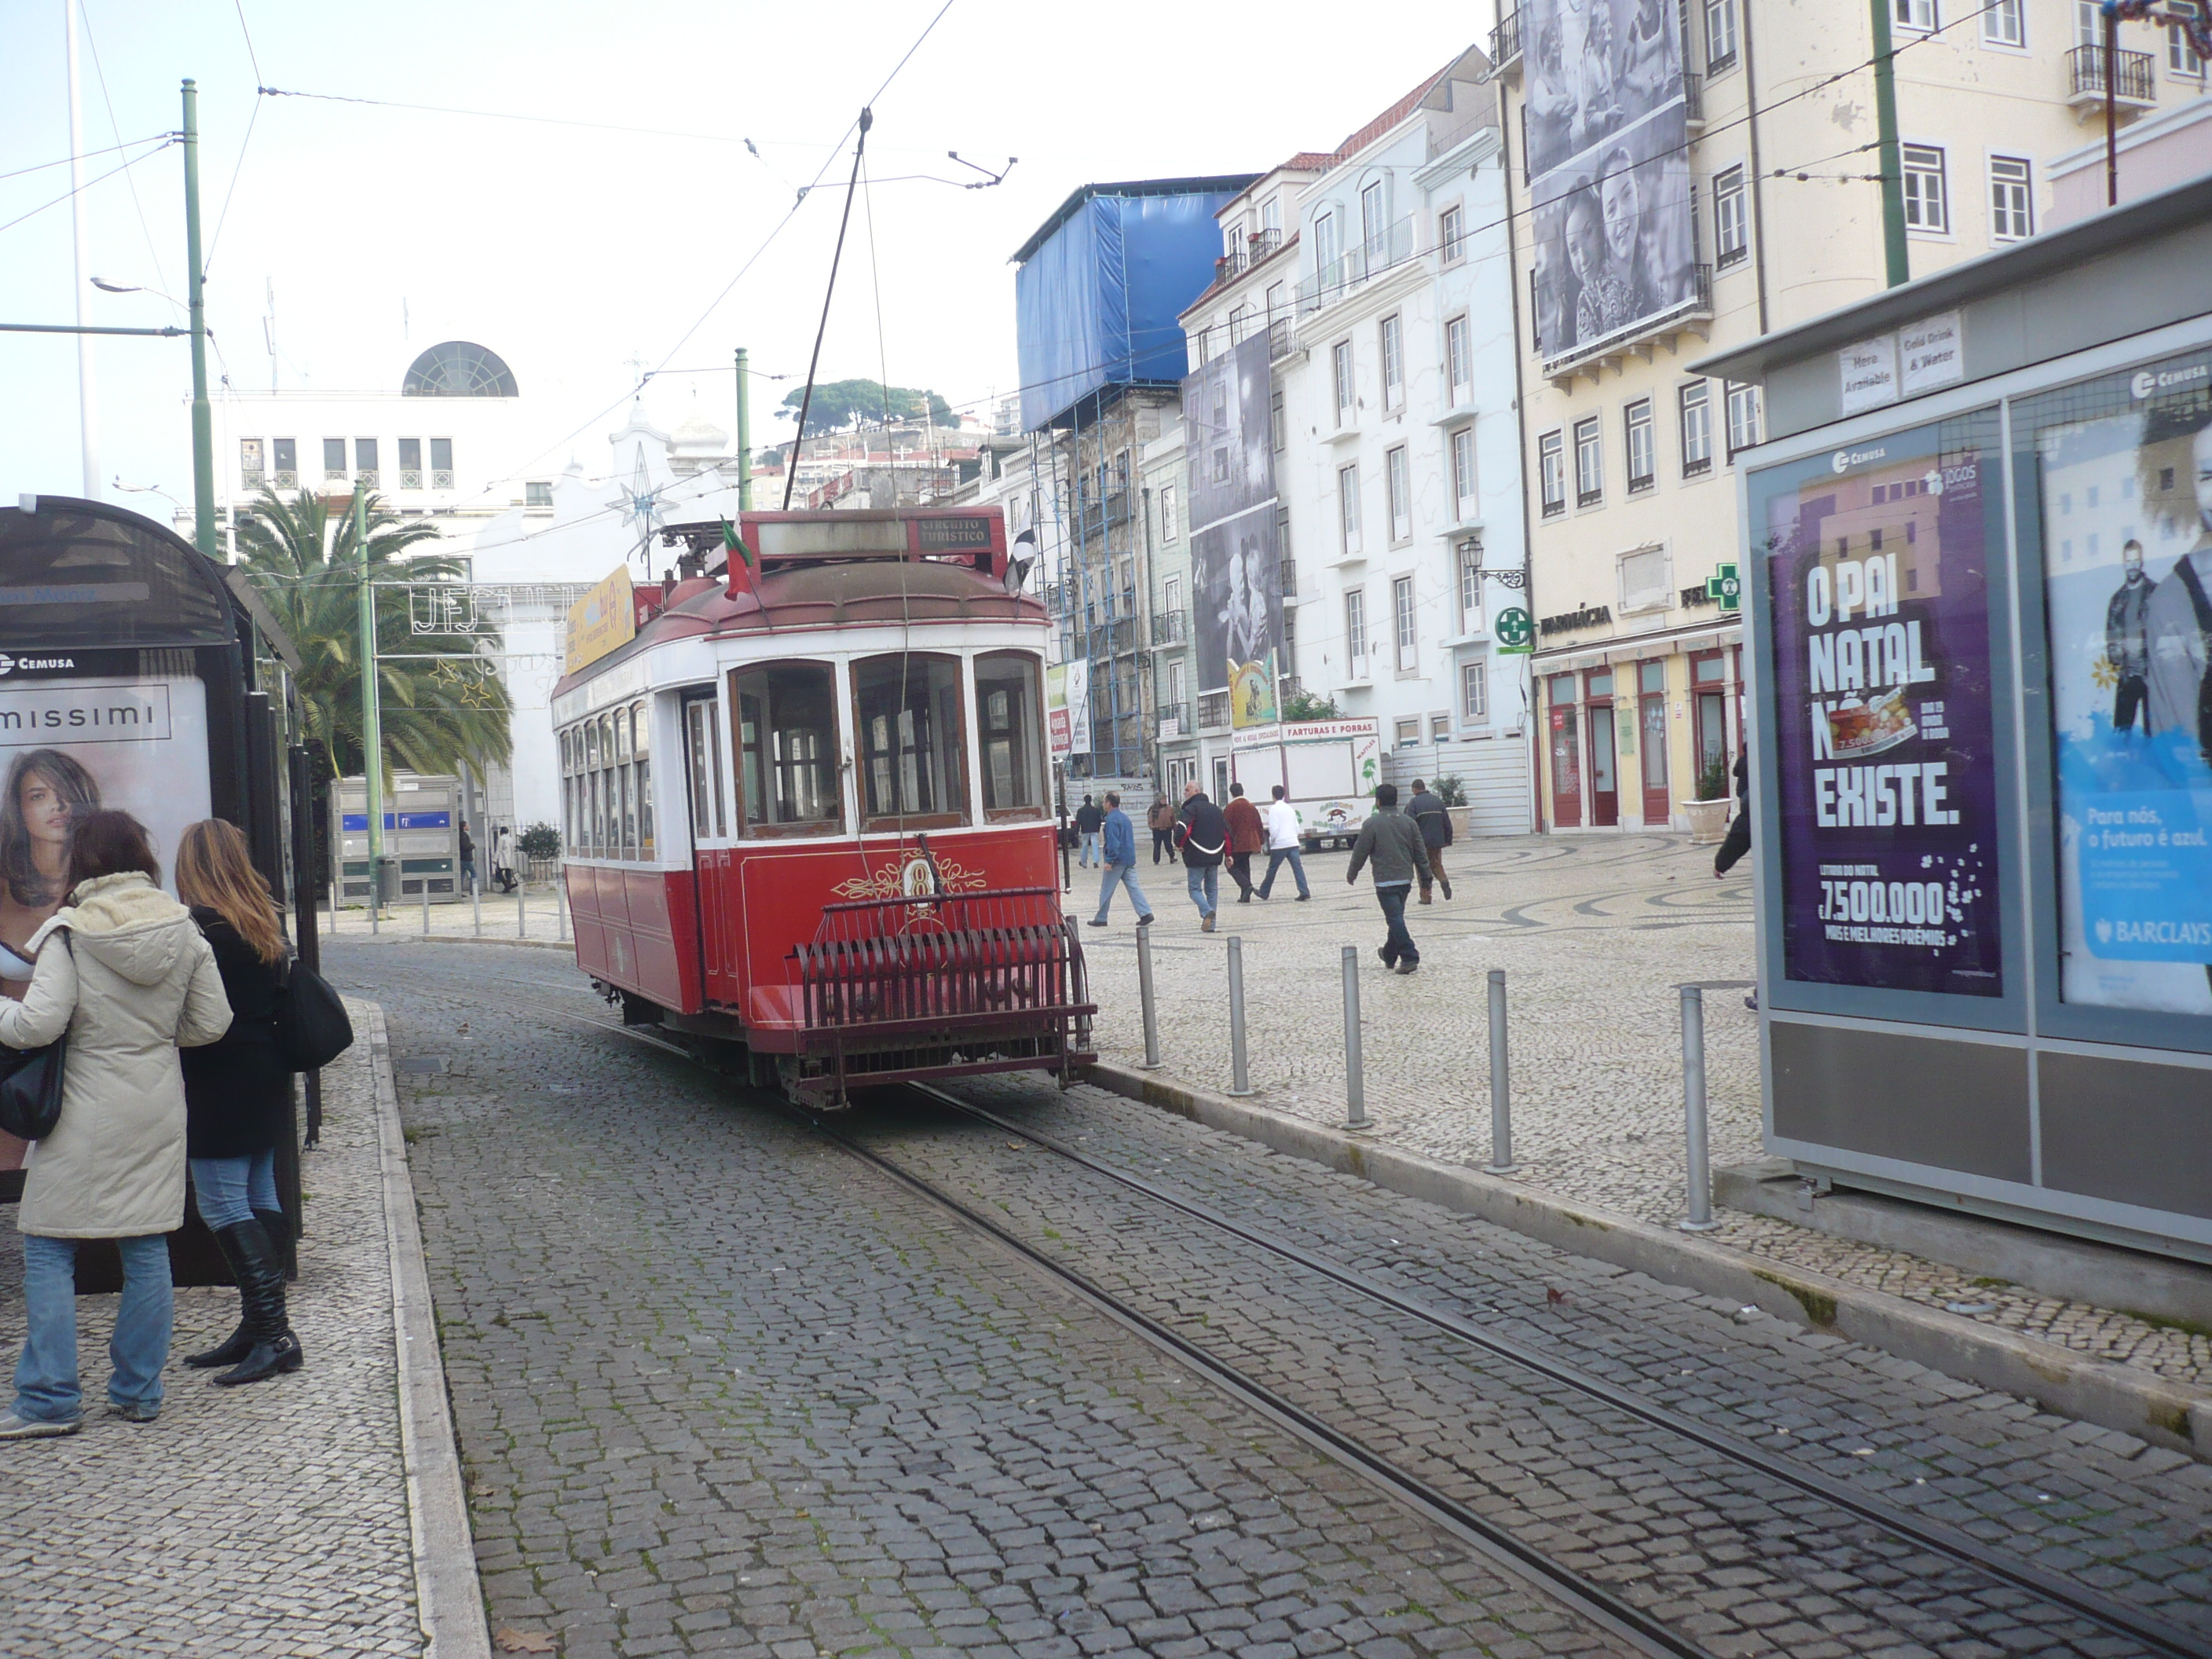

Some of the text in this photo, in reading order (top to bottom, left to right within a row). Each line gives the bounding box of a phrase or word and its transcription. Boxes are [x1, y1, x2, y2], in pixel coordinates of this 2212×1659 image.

[1904, 327, 1954, 351] Cold Drink
[1854, 354, 1878, 369] Here
[1910, 350, 1954, 371] & Water
[1845, 372, 1891, 394] Available
[1808, 552, 1899, 627] O PAI
[19, 657, 75, 669] CEMUSA
[1809, 621, 1936, 694] NATAL
[1287, 727, 1329, 737] FARTURAS
[1340, 723, 1372, 733] PORRAS
[1814, 762, 1960, 827] EXISTE.
[2088, 808, 2123, 824] Para
[2089, 834, 2099, 847] o
[2102, 830, 2154, 849] futuro
[2158, 829, 2167, 846] é
[1825, 925, 1844, 941] MAIS
[1844, 926, 1850, 941] E
[1850, 926, 1900, 944] MELHORES
[2117, 921, 2211, 945] BARCLAYS
